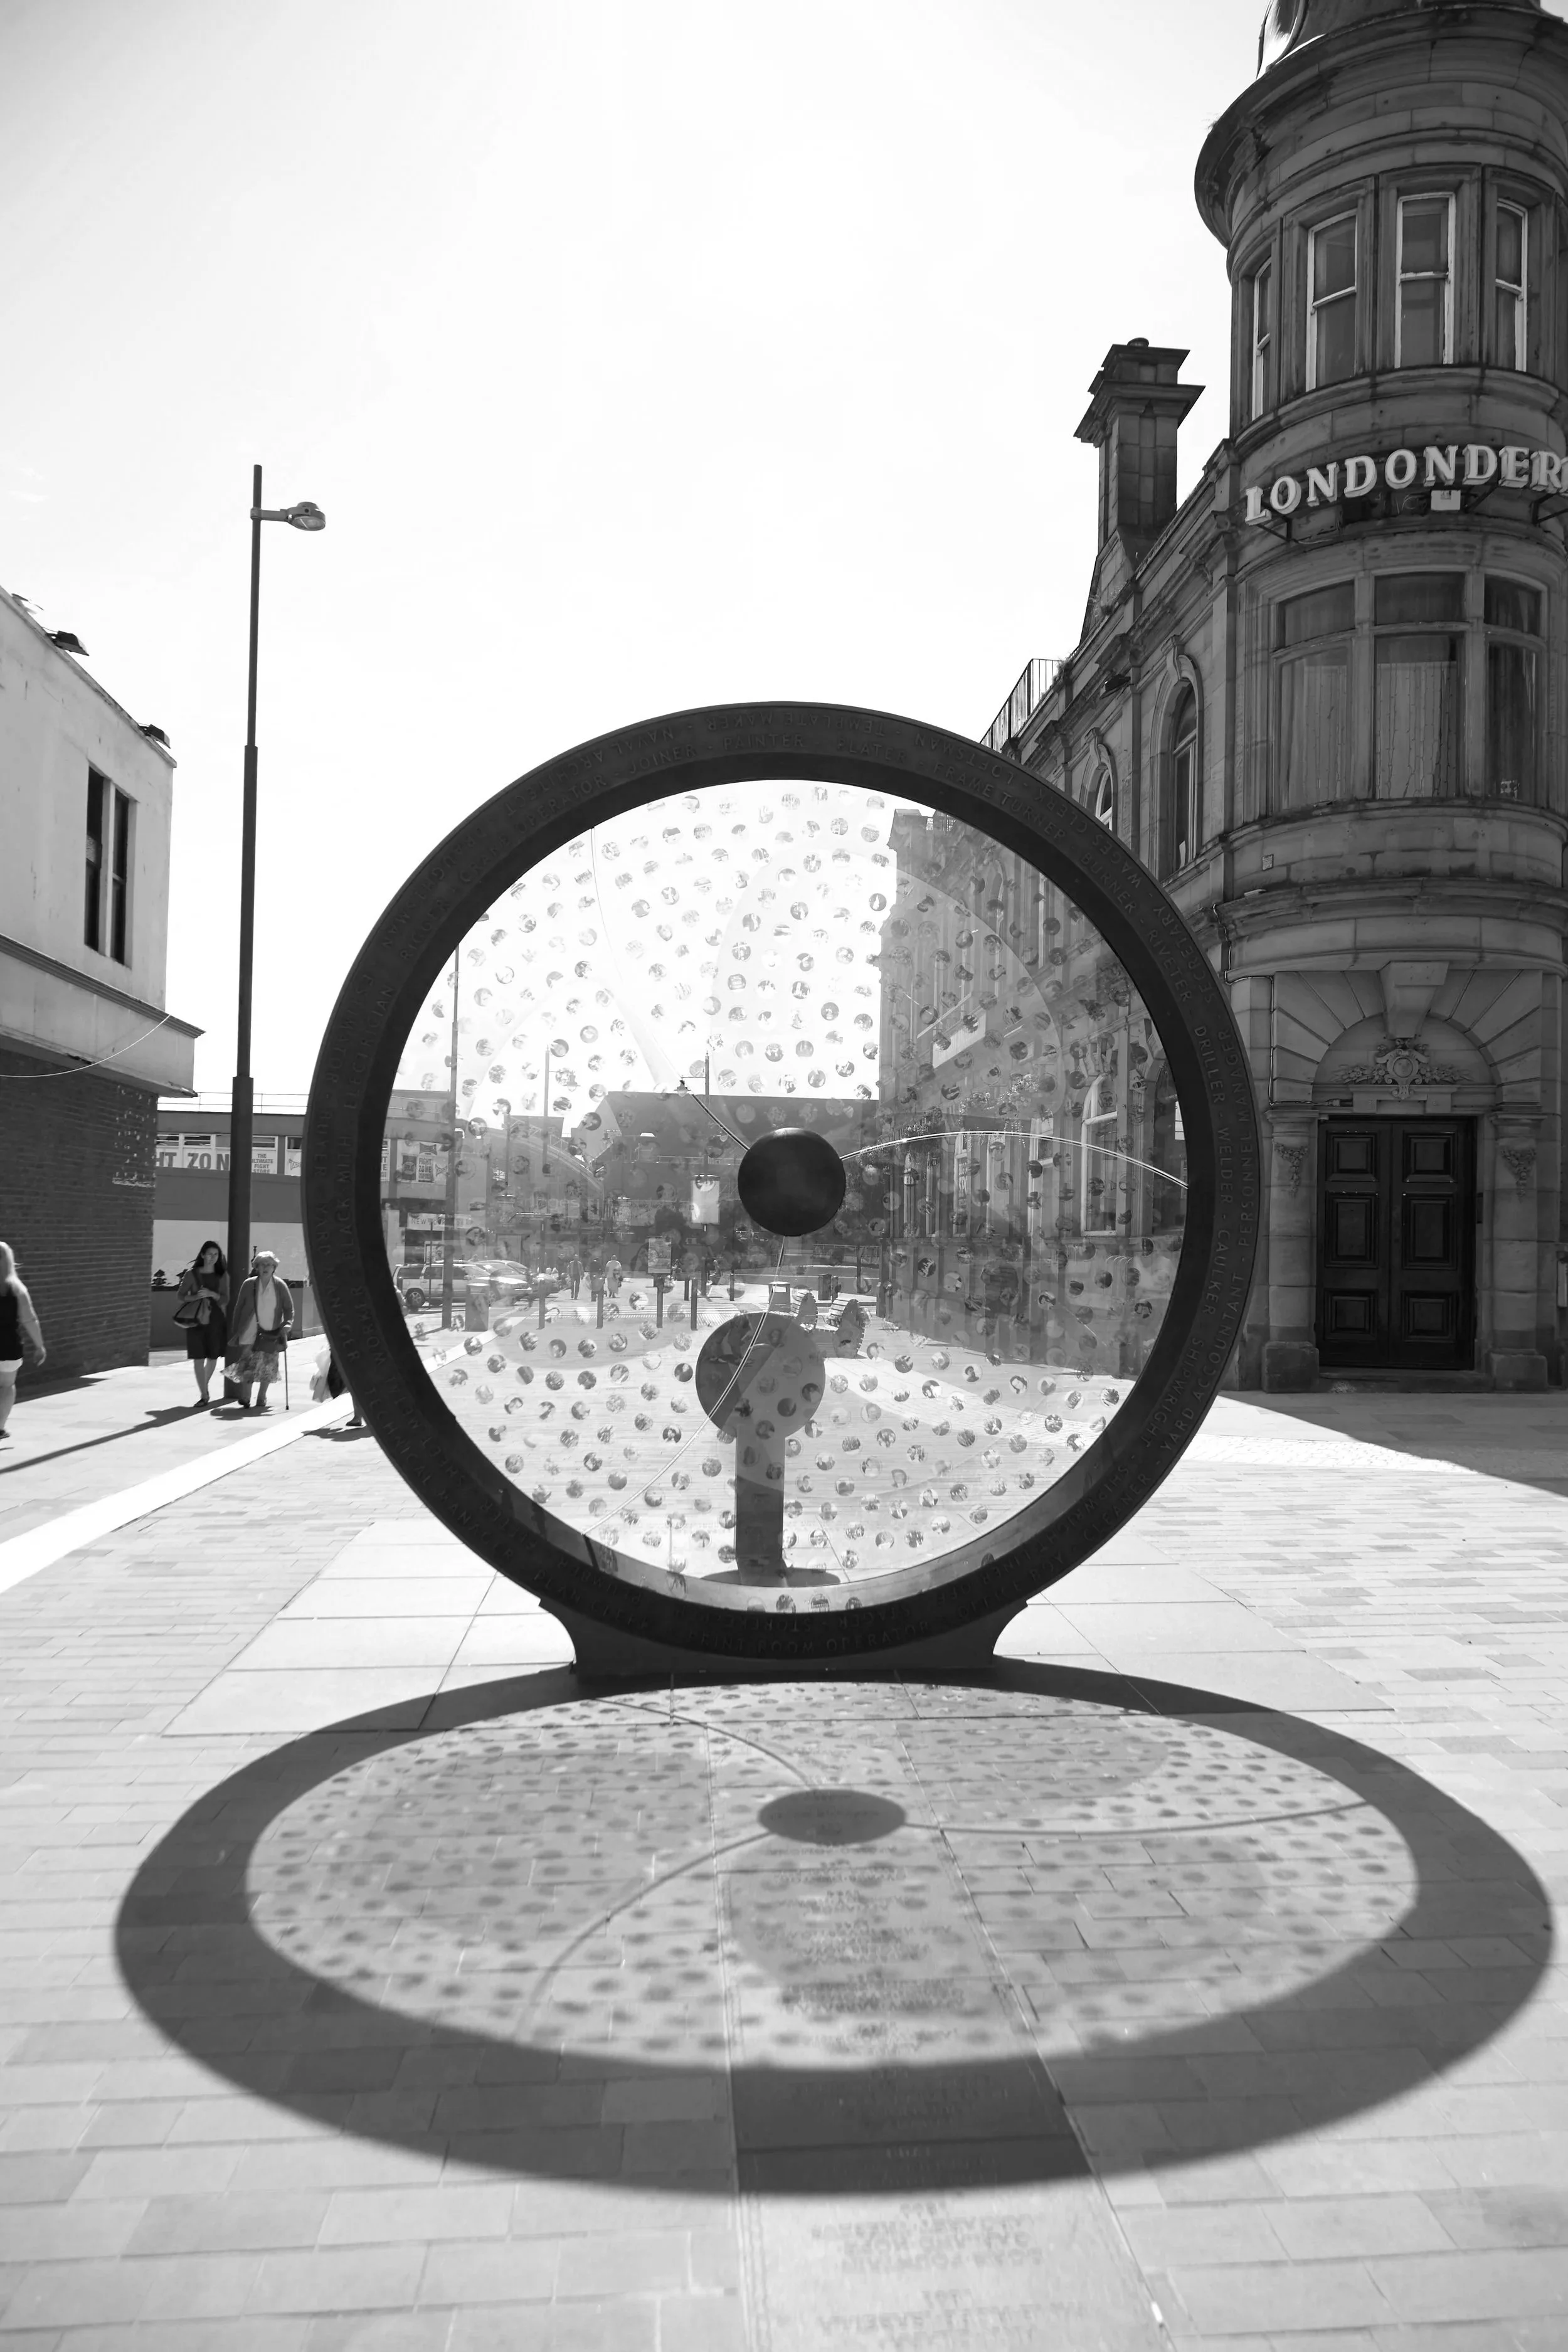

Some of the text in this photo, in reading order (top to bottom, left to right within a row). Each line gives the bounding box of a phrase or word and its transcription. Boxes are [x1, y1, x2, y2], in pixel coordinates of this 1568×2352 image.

[610, 724, 675, 757] NAVAL
[705, 711, 773, 733] MAKER
[723, 733, 805, 752] PAINTER
[785, 711, 888, 738] TEMPLATE
[836, 736, 908, 765] PLATER
[500, 748, 606, 817] ARCHITECT
[625, 741, 698, 776] JOINER
[913, 730, 1017, 787] LOFTSMAN
[931, 760, 996, 800] FRAME
[512, 771, 608, 837] OPERATOR
[997, 790, 1067, 845] TURNER
[1033, 787, 1091, 836] CLERK
[1079, 850, 1140, 915] BURNER
[1089, 831, 1146, 889] WAGES
[396, 893, 453, 963] RIGGER
[1151, 901, 1219, 1005] SECRETARY
[1143, 927, 1194, 1004] RIVETER
[324, 972, 376, 1085] ESTIMATOR
[341, 981, 397, 1110] ELECTRICIAN
[1192, 1024, 1226, 1103] DRILLER
[1216, 1027, 1251, 1123] MANAGER
[313, 1109, 333, 1177] BUYER
[1216, 1125, 1233, 1205] WELDER
[1236, 1130, 1255, 1248] PERSONNEL
[314, 1202, 333, 1255] YARD
[1200, 1228, 1232, 1316] CAULKER
[320, 1265, 363, 1363] MANAGER
[348, 1284, 389, 1367] WORKER
[1188, 1272, 1246, 1402] ACCOUNTANT
[1136, 1336, 1205, 1449] SHIPWRIGHT
[418, 1431, 468, 1488] SHEET
[1157, 1404, 1196, 1454] YARD
[1032, 1462, 1130, 1554] SHIPWRIGHT
[1079, 1470, 1151, 1543] CLEANER
[554, 1555, 643, 1606] PLUMBER
[979, 1547, 1032, 1586] LINER
[672, 1603, 812, 1633] STOREKEPER
[837, 1601, 909, 1629] STAGER
